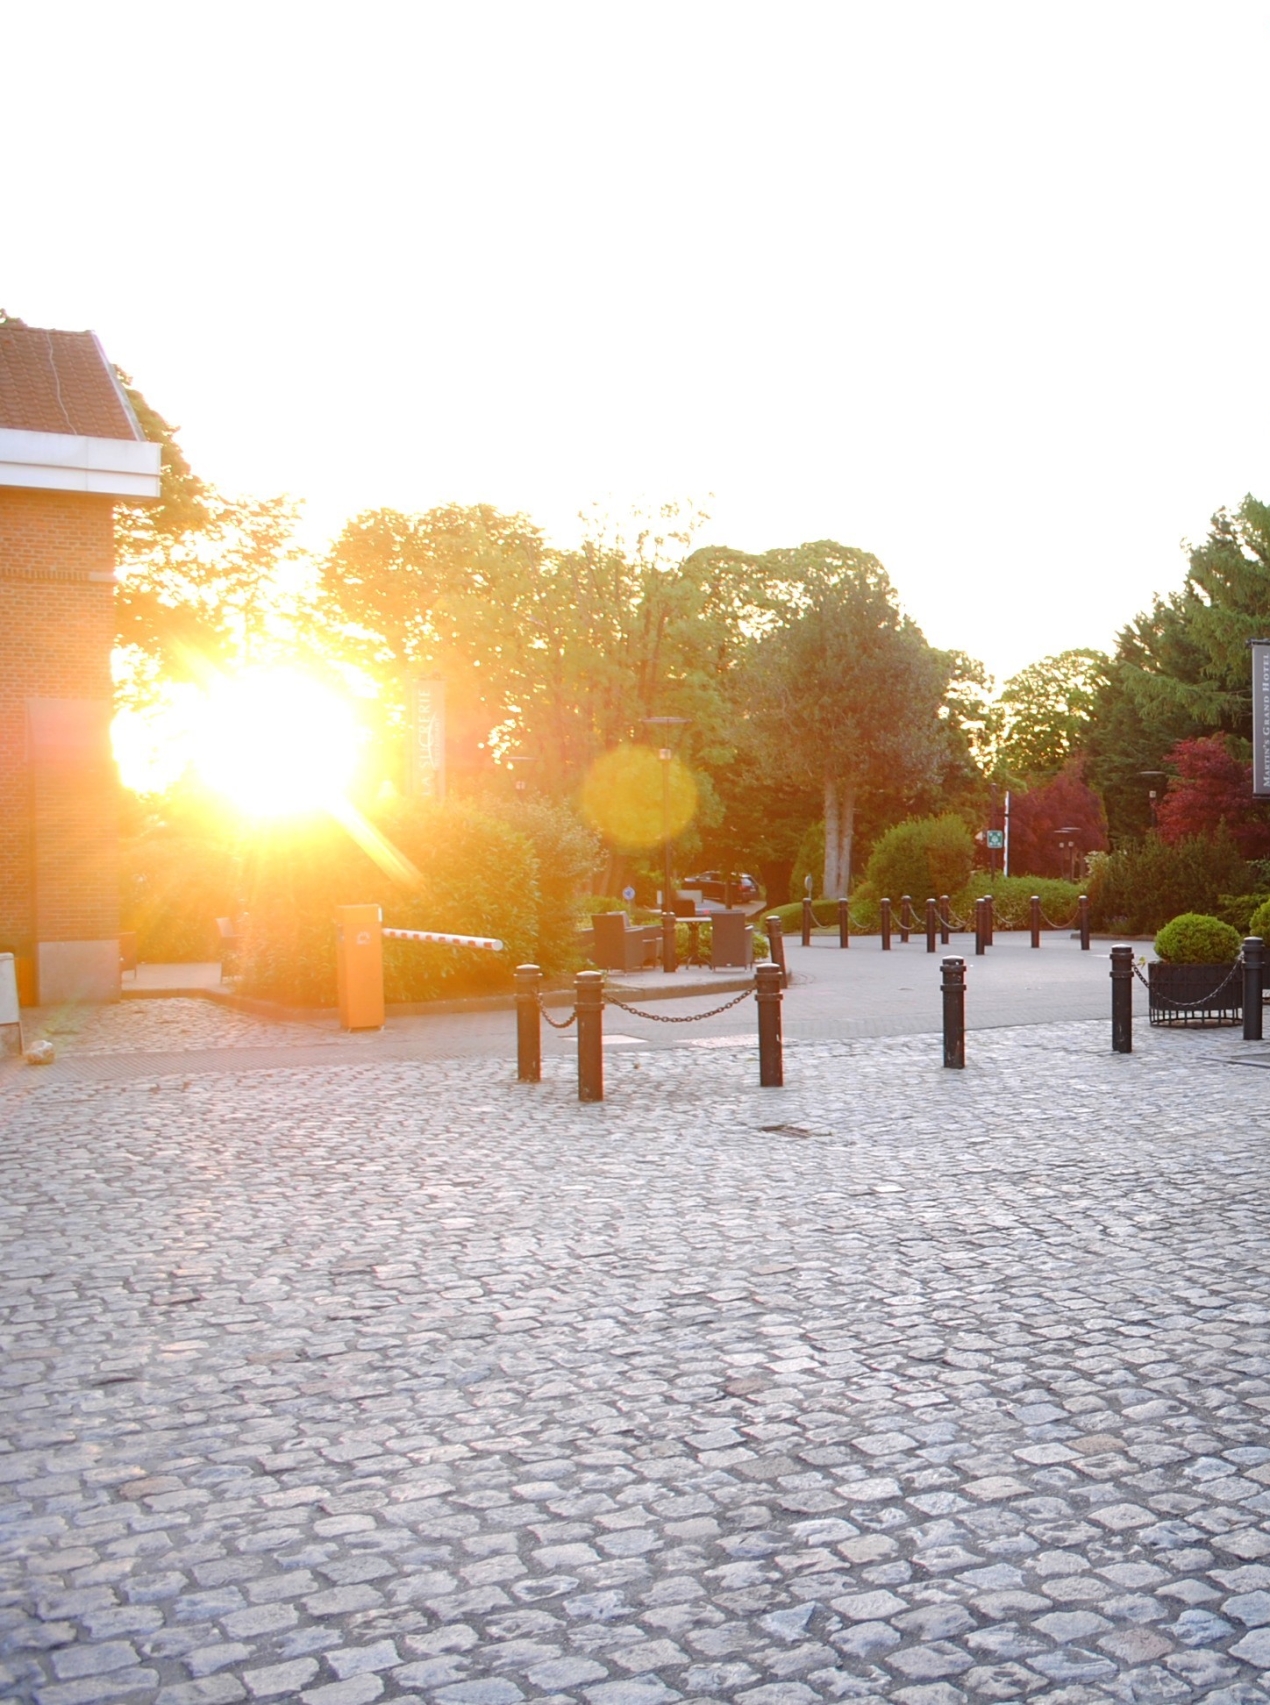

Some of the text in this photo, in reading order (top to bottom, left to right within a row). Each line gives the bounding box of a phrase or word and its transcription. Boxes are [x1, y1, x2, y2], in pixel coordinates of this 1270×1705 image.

[1262, 653, 1270, 691] HOTEL
[1262, 696, 1270, 736] GRAND
[418, 689, 431, 797] LA SUCRERIE
